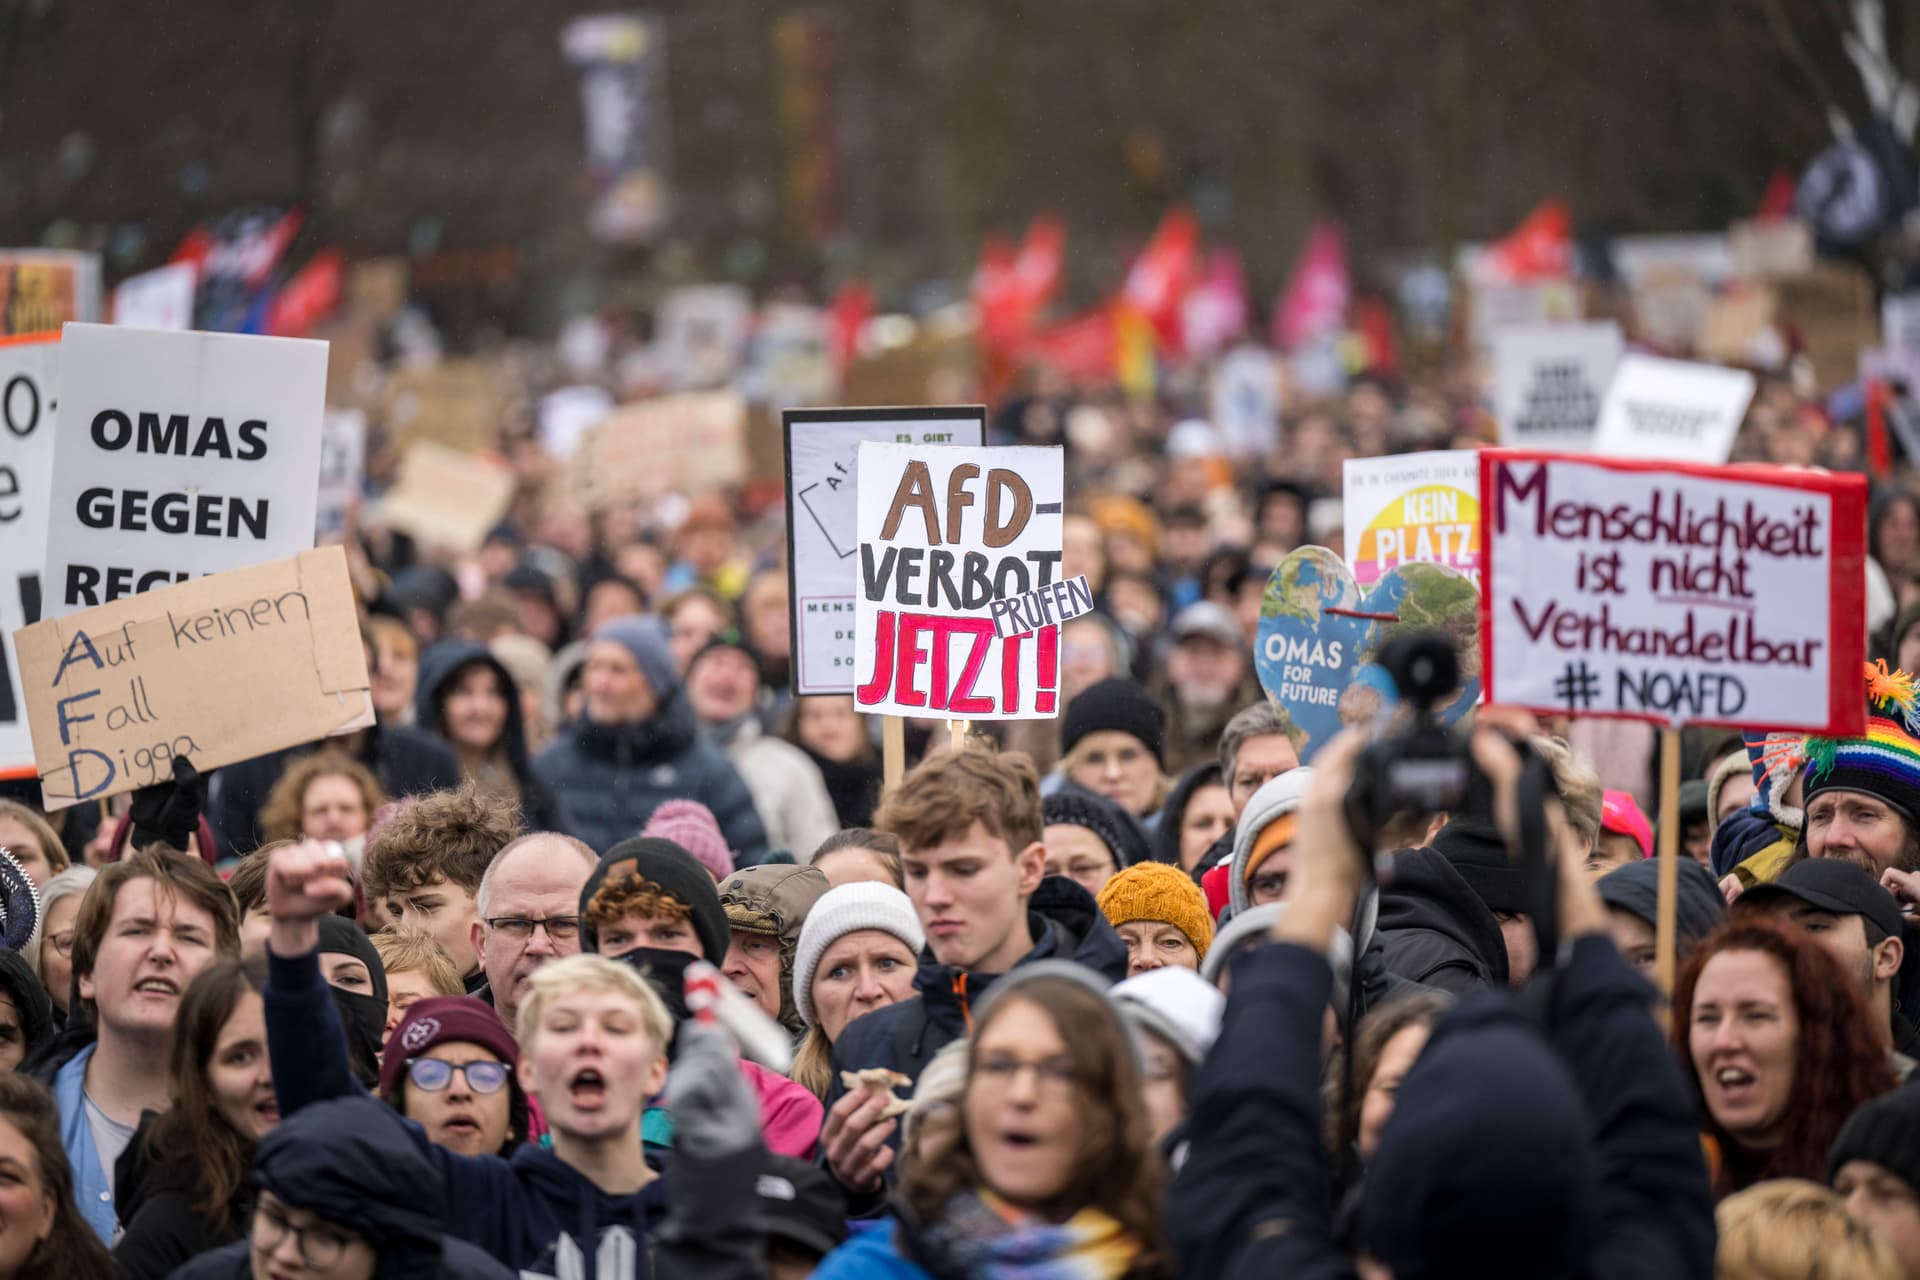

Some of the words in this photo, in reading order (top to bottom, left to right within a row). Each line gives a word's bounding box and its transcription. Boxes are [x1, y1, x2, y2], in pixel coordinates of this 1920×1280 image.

[90, 408, 268, 462] OMAS
[896, 434, 912, 443] ES
[923, 433, 953, 443] GIBT
[75, 487, 269, 540] GEGEN
[879, 459, 1062, 548] AfD-
[1403, 490, 1458, 525] KEIN
[1496, 462, 1823, 557] Menschlichkeit
[1376, 524, 1473, 570] PLATZ
[860, 543, 1062, 611] VERBOT
[1577, 551, 1626, 594] ist
[1651, 551, 1755, 599] nicht
[990, 577, 1093, 638] PRÜFEN
[1512, 597, 1822, 669] Verhandelbar
[52, 620, 137, 688] Auf
[167, 592, 311, 649] keinen
[857, 610, 1059, 715] JETZT!
[1265, 633, 1343, 669] OMAS
[1280, 683, 1338, 706] FUTURE
[1282, 665, 1311, 683] FOR
[1554, 661, 1601, 710] #
[1617, 669, 1747, 716] NOAFD
[57, 675, 158, 746] Fall
[68, 735, 201, 800] Digga
